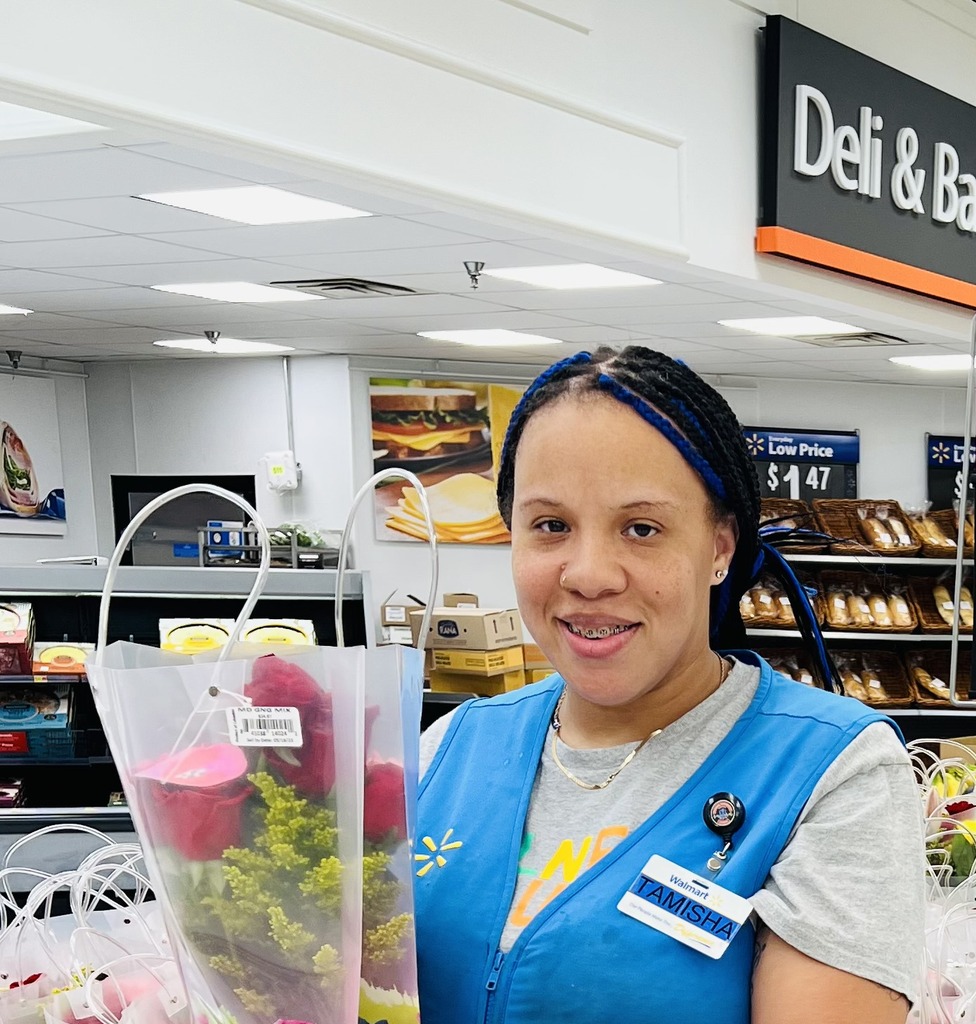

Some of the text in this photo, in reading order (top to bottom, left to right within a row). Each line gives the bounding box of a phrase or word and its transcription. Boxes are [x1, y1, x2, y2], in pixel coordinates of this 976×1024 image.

[794, 84, 884, 199] Deli
[891, 126, 926, 214] &
[768, 442, 834, 458] Low Price
[635, 875, 734, 940] TAMISHA
[669, 874, 710, 900] Walmart
